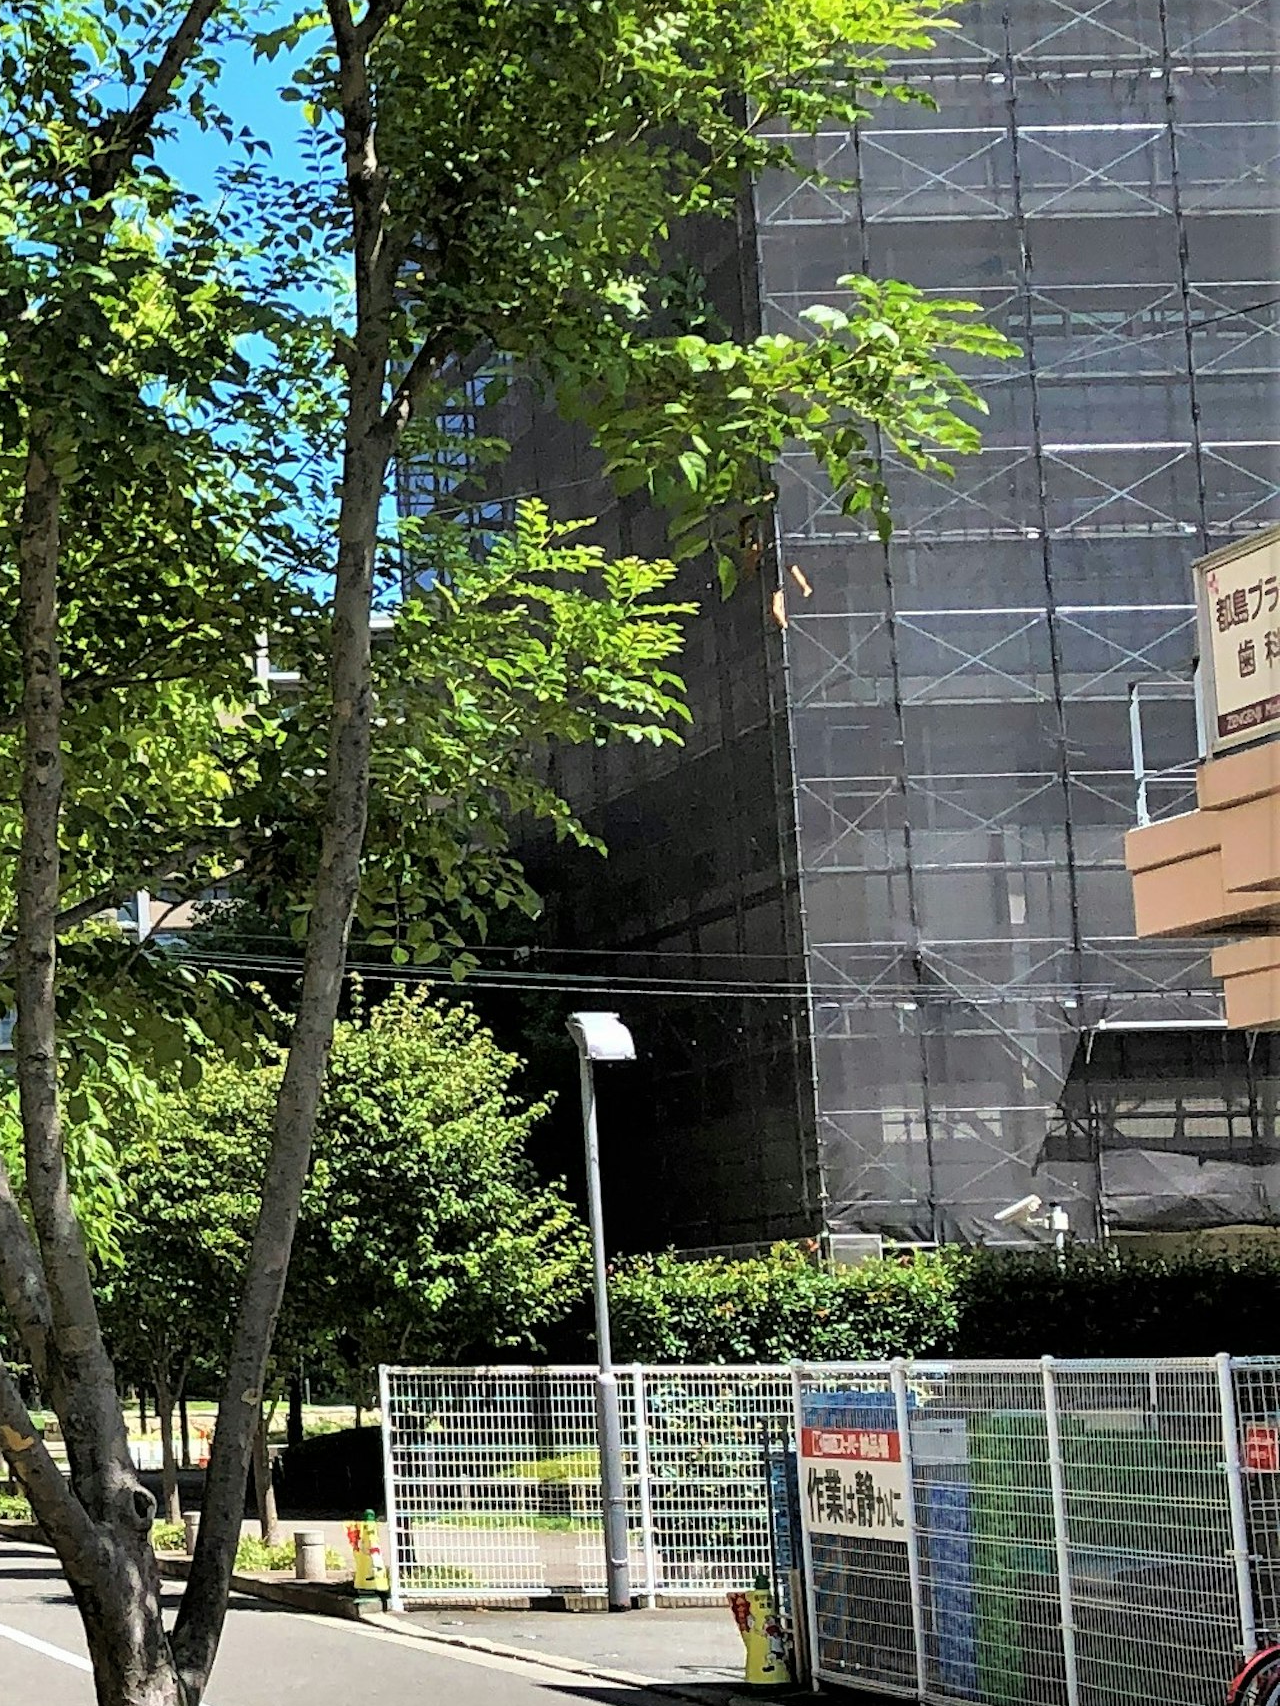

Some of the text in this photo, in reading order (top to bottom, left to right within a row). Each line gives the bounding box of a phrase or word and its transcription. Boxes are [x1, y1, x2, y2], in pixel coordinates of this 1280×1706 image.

[807, 1466, 904, 1528] 作業は静かに
